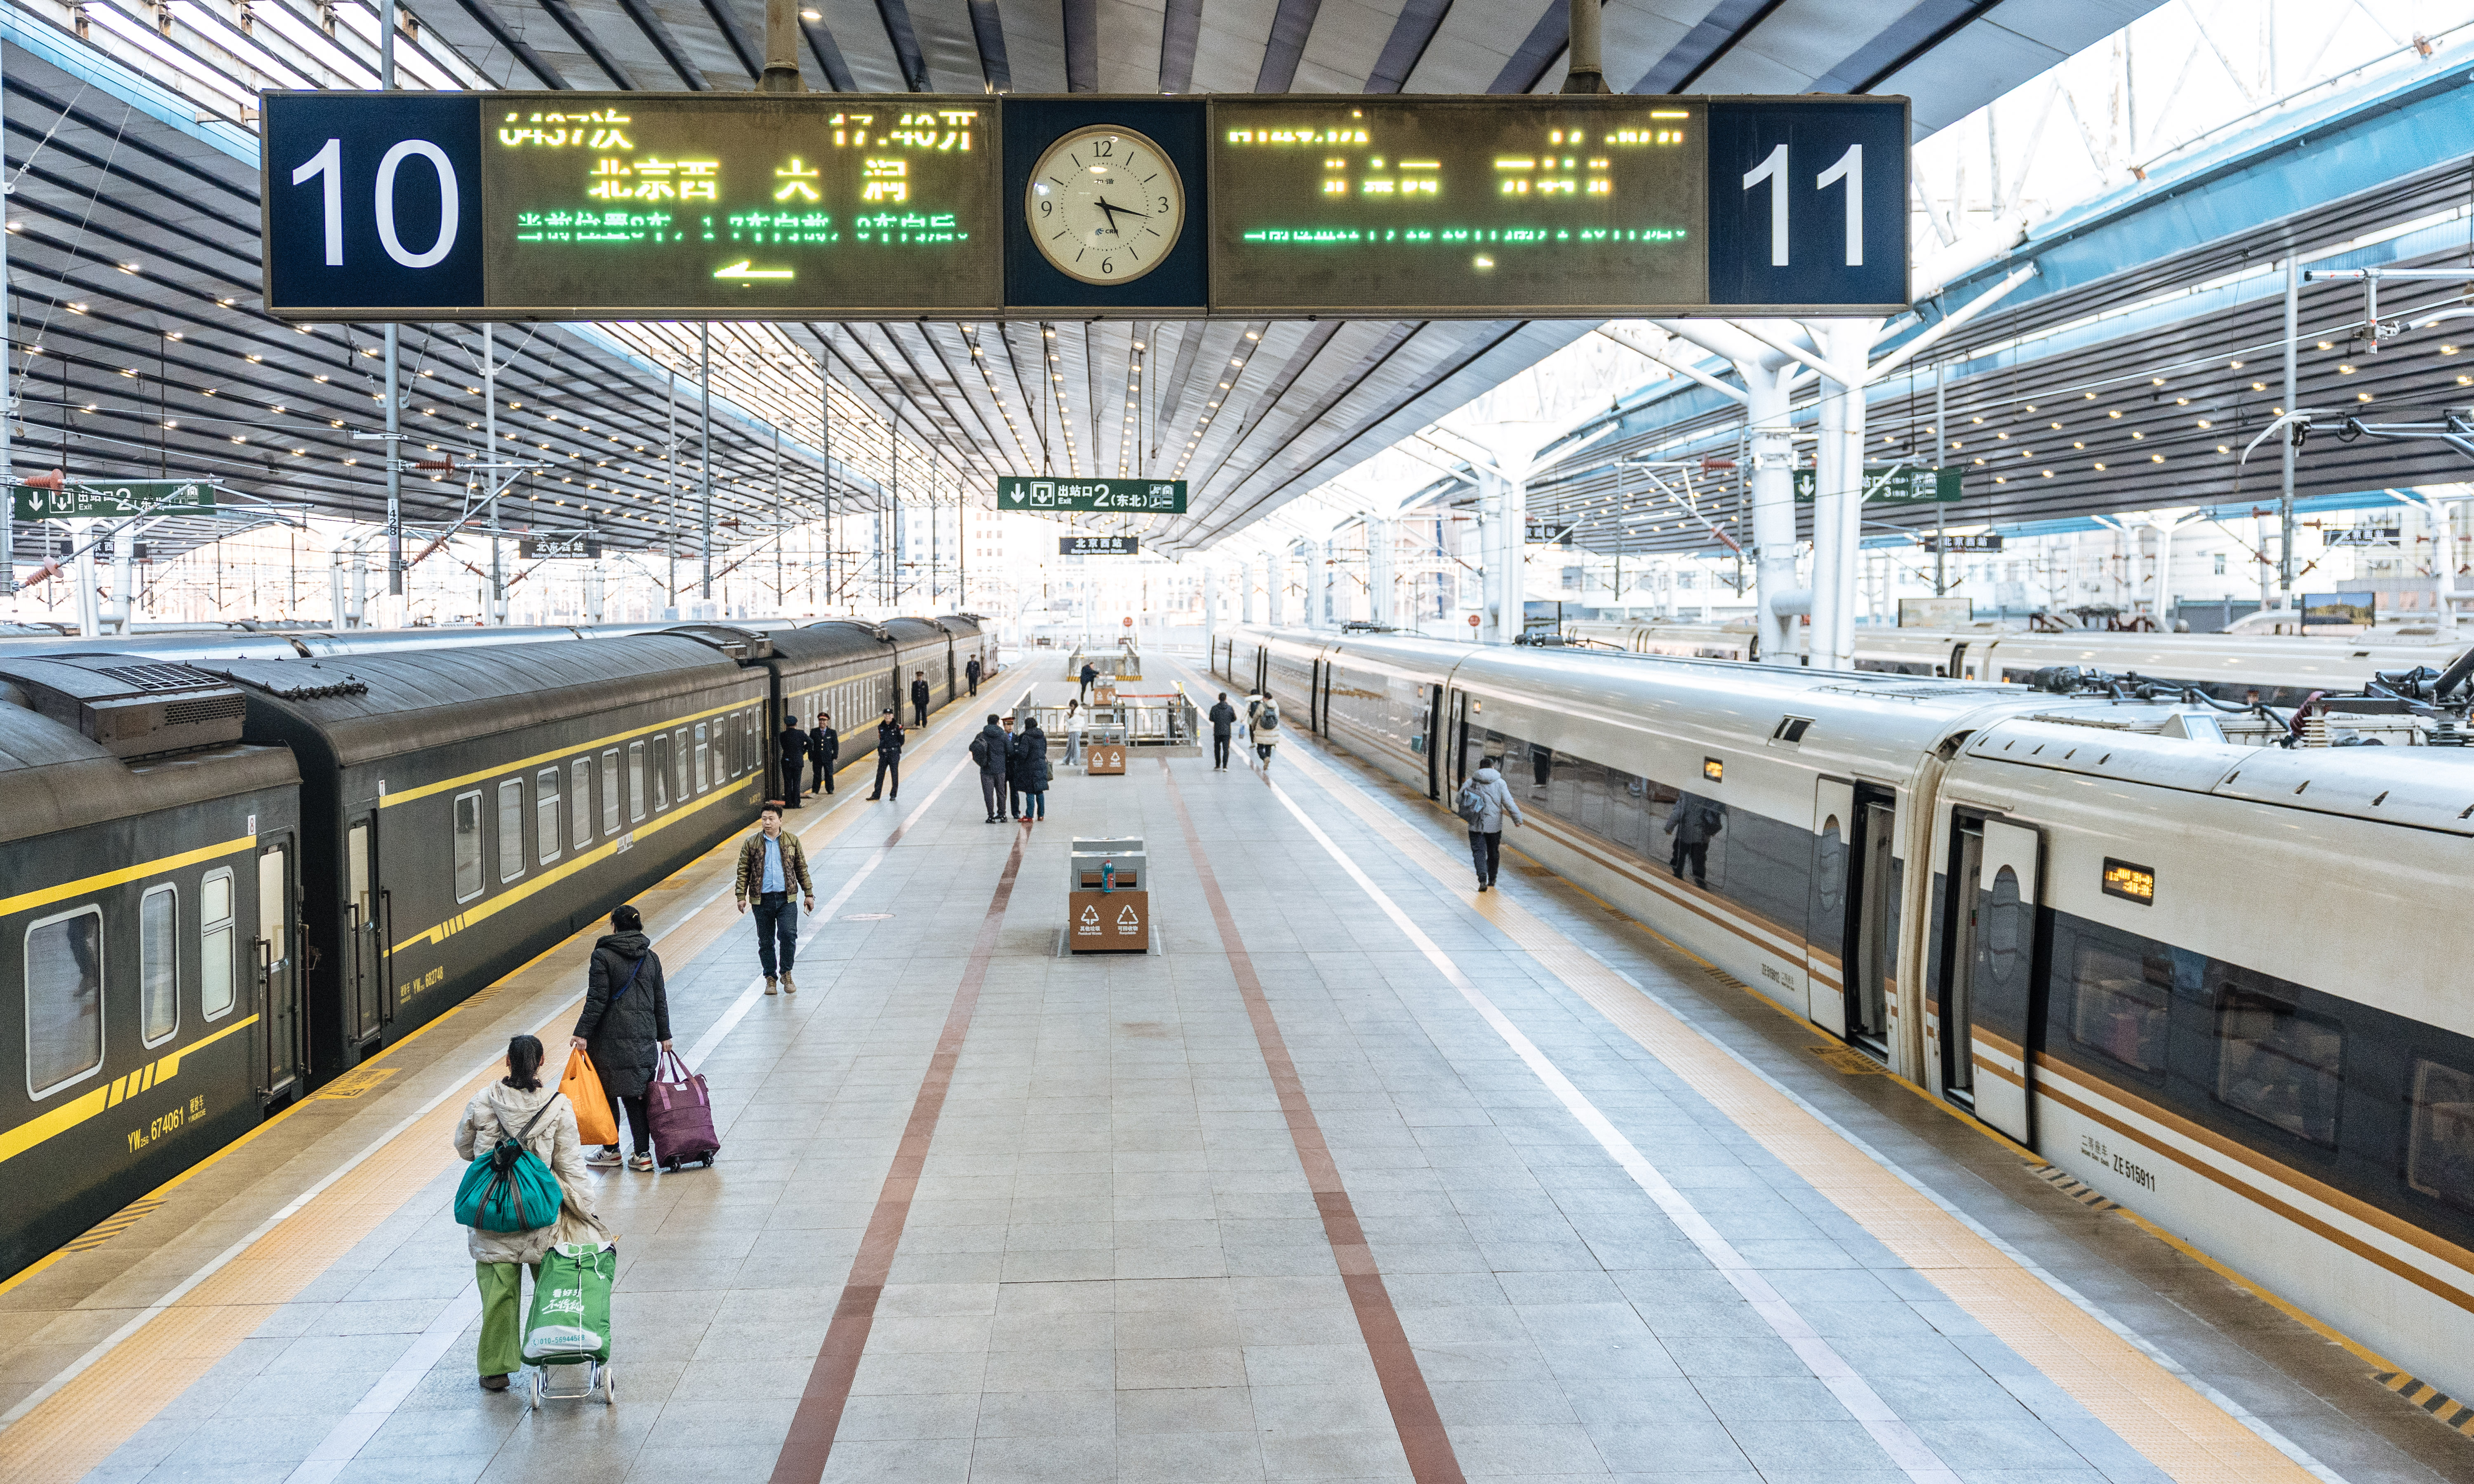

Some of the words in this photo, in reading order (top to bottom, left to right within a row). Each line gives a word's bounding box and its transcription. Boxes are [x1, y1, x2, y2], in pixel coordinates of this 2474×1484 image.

[1093, 141, 1112, 157] 12
[589, 159, 720, 200] 北京西
[292, 139, 459, 268] 10
[1041, 201, 1052, 218] 9
[1158, 197, 1169, 213] 3
[1743, 144, 1863, 267] 11
[1102, 257, 1112, 274] 6
[116, 488, 132, 511] 2
[1058, 485, 1092, 496] 出站口
[1094, 484, 1109, 507] 2
[1111, 494, 1147, 507] (东北)
[536, 541, 584, 552] 北京西站
[1076, 538, 1122, 548] 北京西站
[250, 817, 254, 833] 8
[151, 1106, 183, 1140] 674061
